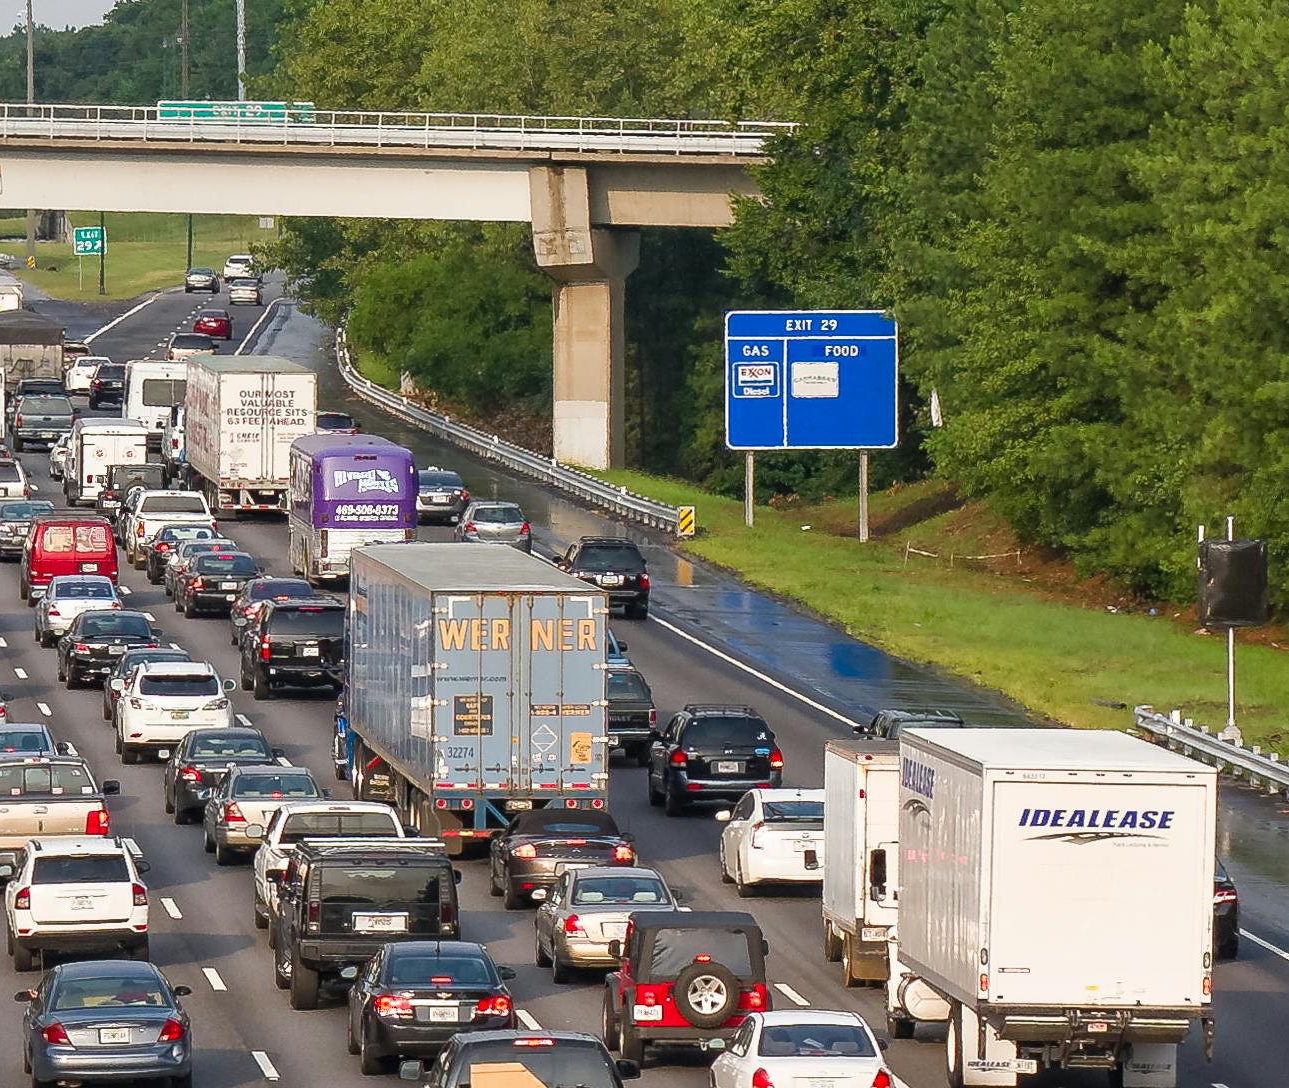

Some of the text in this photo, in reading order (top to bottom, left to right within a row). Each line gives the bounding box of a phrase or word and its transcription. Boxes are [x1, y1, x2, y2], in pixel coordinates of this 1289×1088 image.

[76, 240, 93, 251] 29
[785, 319, 838, 331] EXIT 29
[742, 345, 770, 357] GAS
[824, 345, 859, 357] FOOD
[740, 368, 772, 378] EXXON
[239, 390, 296, 399] OUR MOST
[742, 387, 770, 396] Diesel
[240, 399, 295, 408] VALUABLE
[226, 408, 308, 417] RESOURCE SITS
[242, 417, 265, 426] FEET
[447, 746, 475, 759] 32274
[1018, 808, 1176, 830] IDEALEASE
